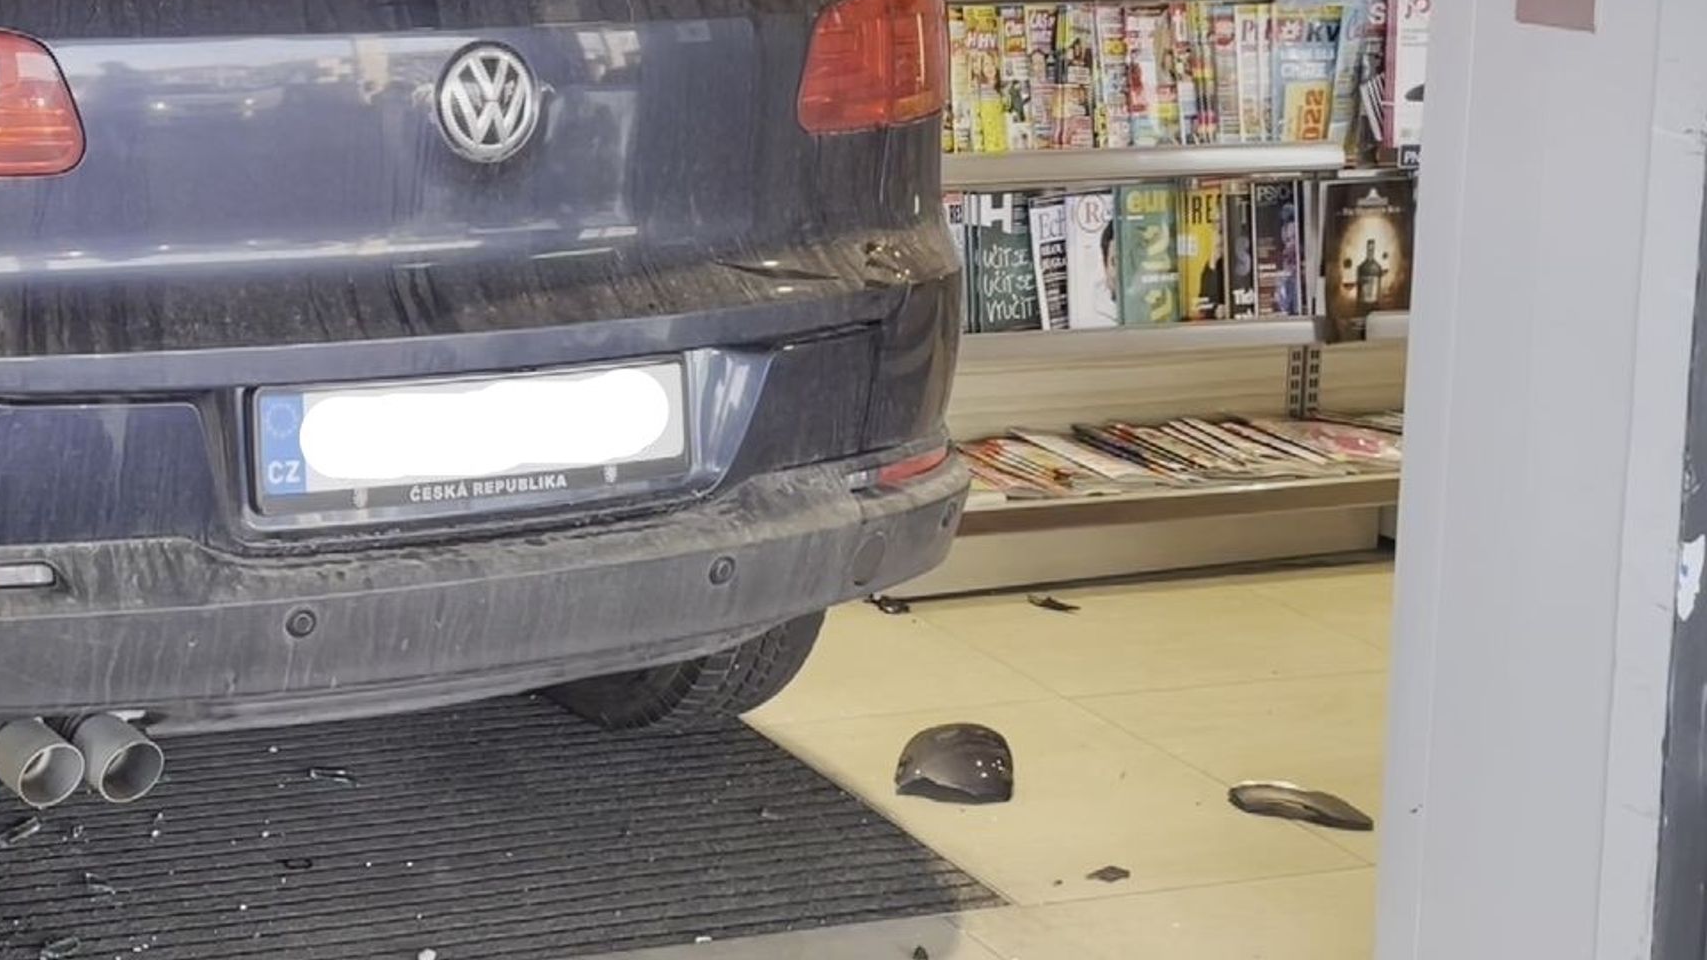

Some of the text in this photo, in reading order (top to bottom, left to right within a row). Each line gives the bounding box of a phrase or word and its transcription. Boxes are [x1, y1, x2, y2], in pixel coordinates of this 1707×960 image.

[268, 461, 301, 485] CZ
[410, 473, 568, 502] ČESKÁ REPUBLIKA
